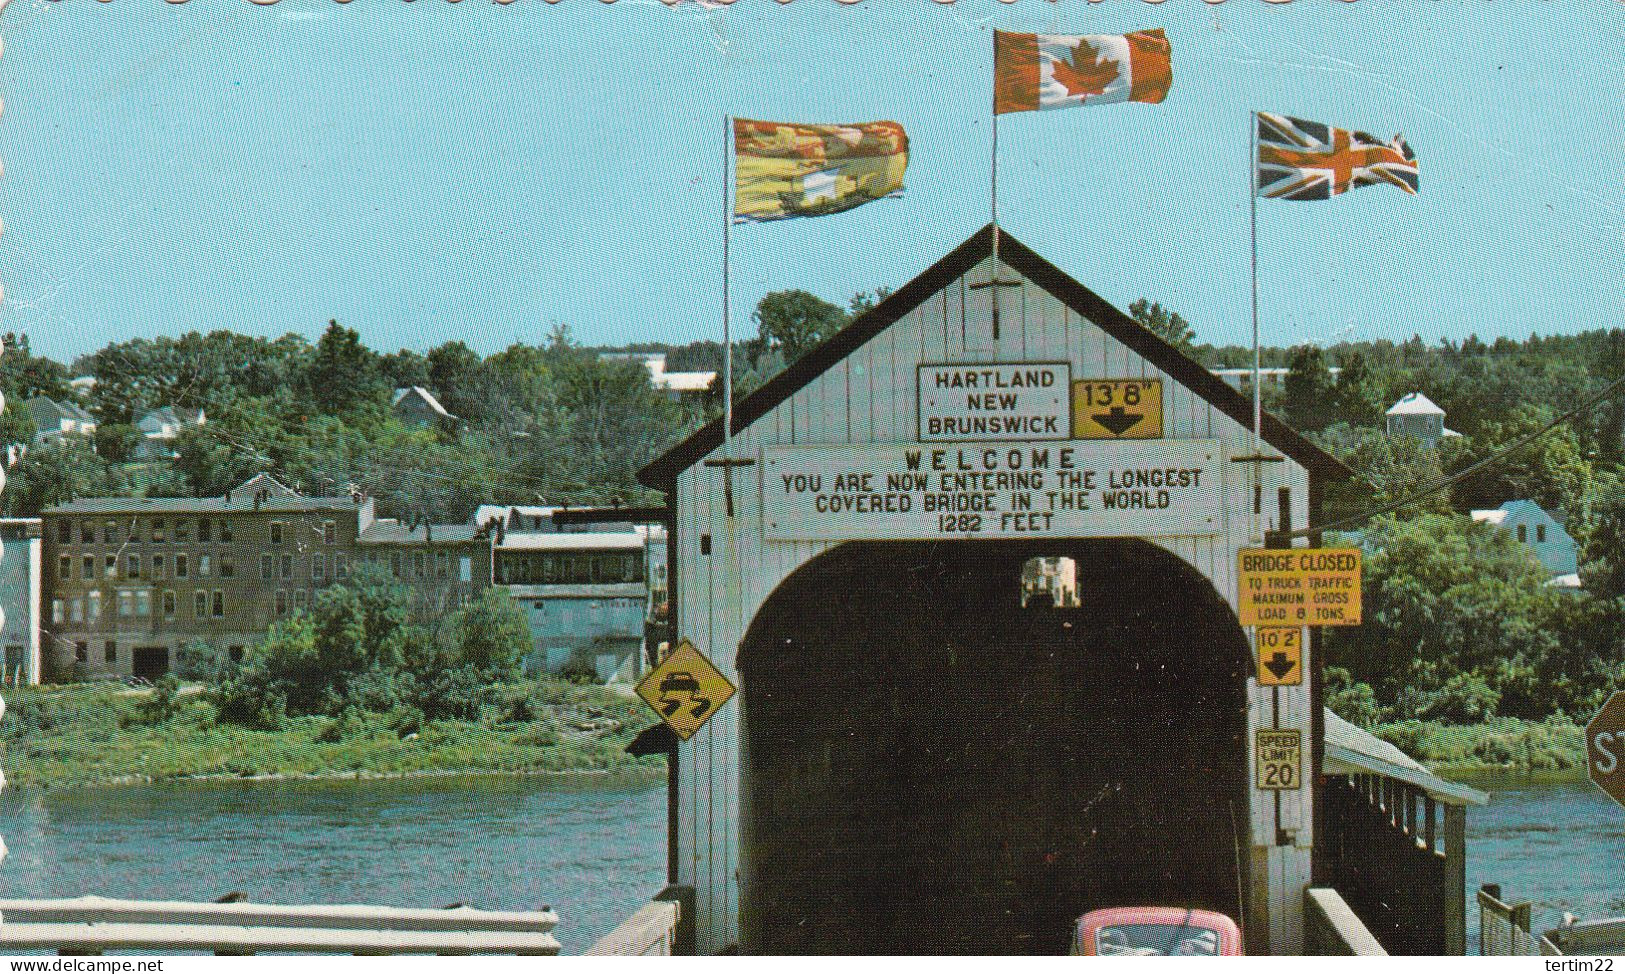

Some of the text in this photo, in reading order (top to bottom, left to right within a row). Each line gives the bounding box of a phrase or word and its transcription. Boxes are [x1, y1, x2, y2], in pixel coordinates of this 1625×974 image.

[936, 371, 1054, 388] HARTLAND
[967, 394, 1017, 410] NEW
[1084, 380, 1151, 406] 13'8"
[928, 418, 1058, 436] BRUNSWICK
[905, 449, 1075, 469] WELCOME
[782, 468, 1202, 493] YOU ARE NOW ENTERING THE LONGEST
[816, 491, 1170, 513] COVERED BRIDGE IN THE WORLD
[939, 513, 1054, 533] 1282 FEET
[1243, 554, 1356, 572] BRIDGE CLOSED
[1249, 576, 1352, 590] TO TRUCK TRAFFIC
[1253, 592, 1349, 604] MAXIMUM GROSS
[1257, 607, 1344, 620] LOAD 8 TONS
[1259, 736, 1297, 747] SPEED
[1262, 750, 1294, 761] LIMIT
[1594, 730, 1625, 773] S
[1265, 763, 1292, 786] 20
